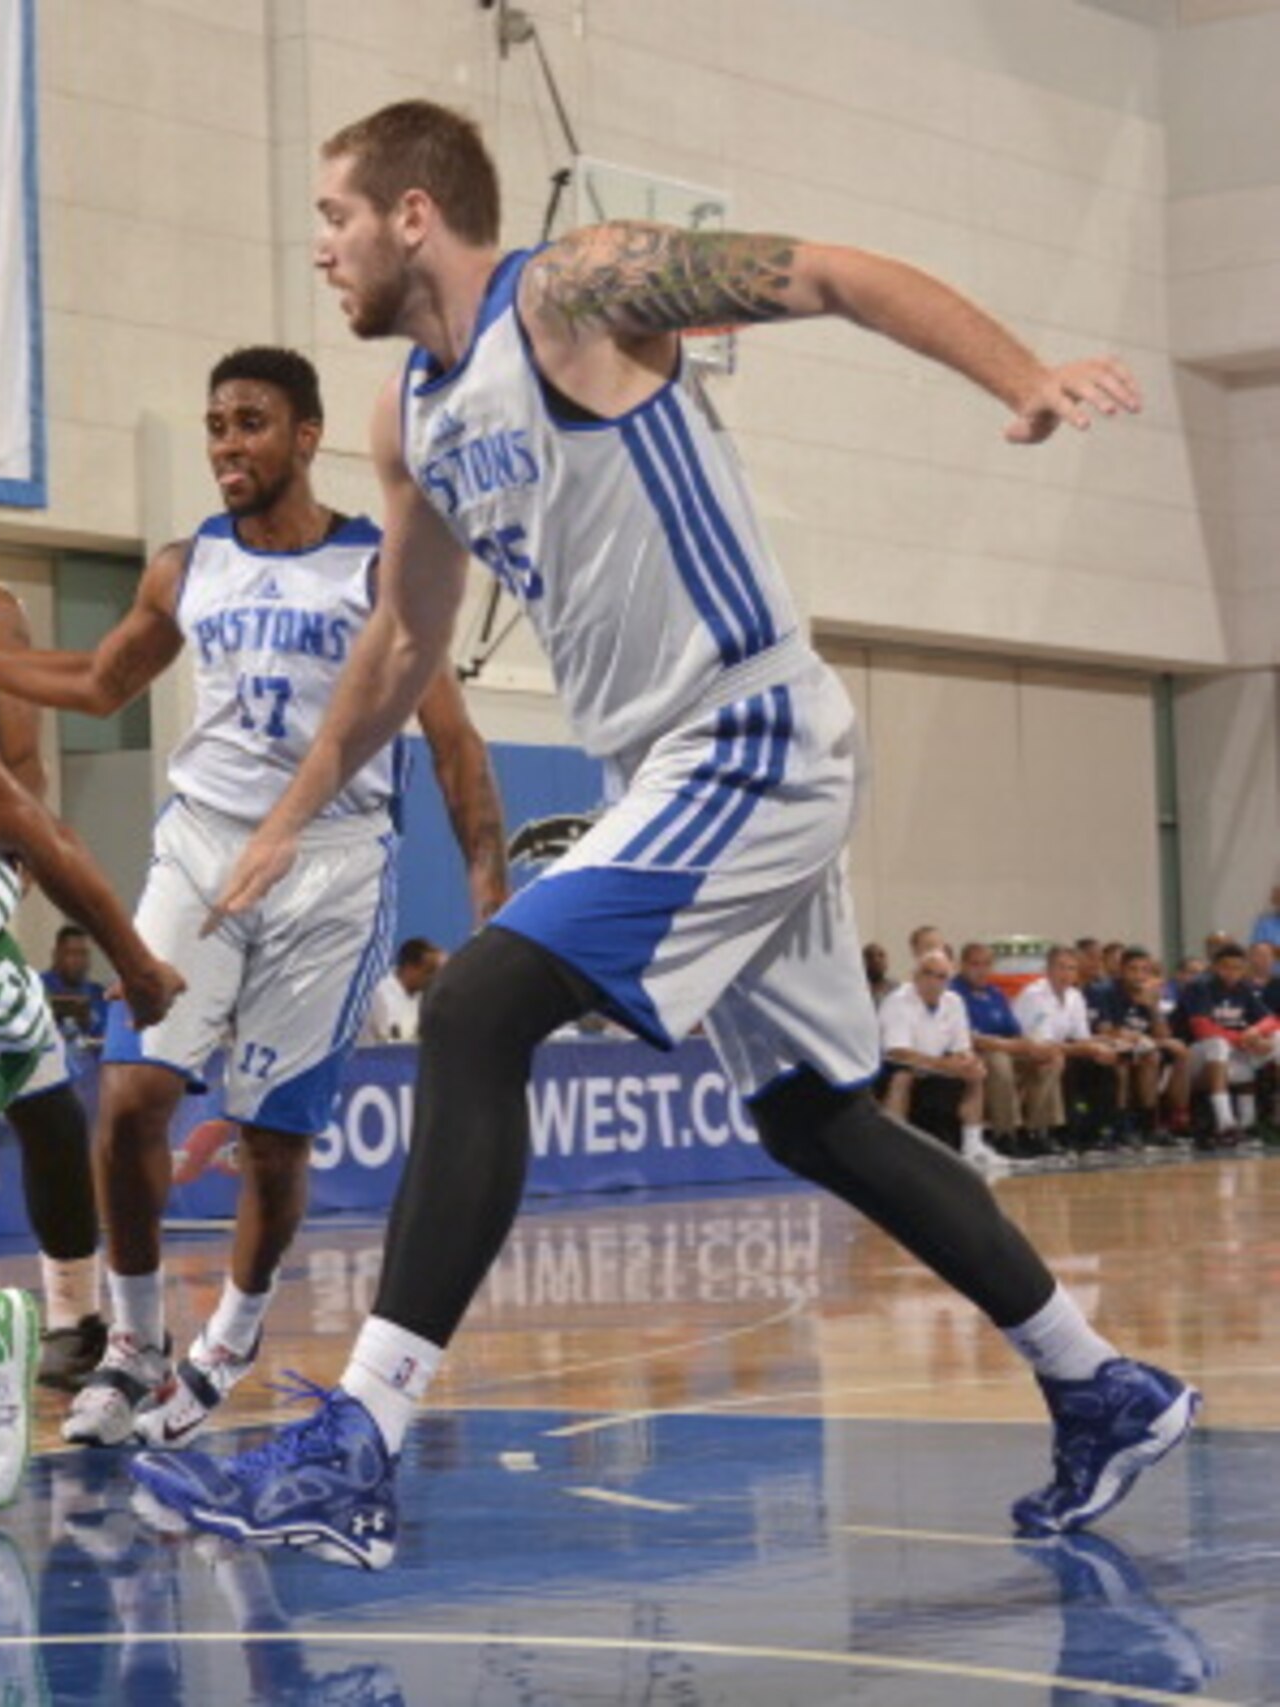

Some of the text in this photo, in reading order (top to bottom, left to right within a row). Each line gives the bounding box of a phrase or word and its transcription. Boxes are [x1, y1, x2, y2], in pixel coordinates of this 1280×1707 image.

[194, 607, 351, 664] PISTONS
[236, 674, 293, 738] 17
[239, 1041, 278, 1079] 17
